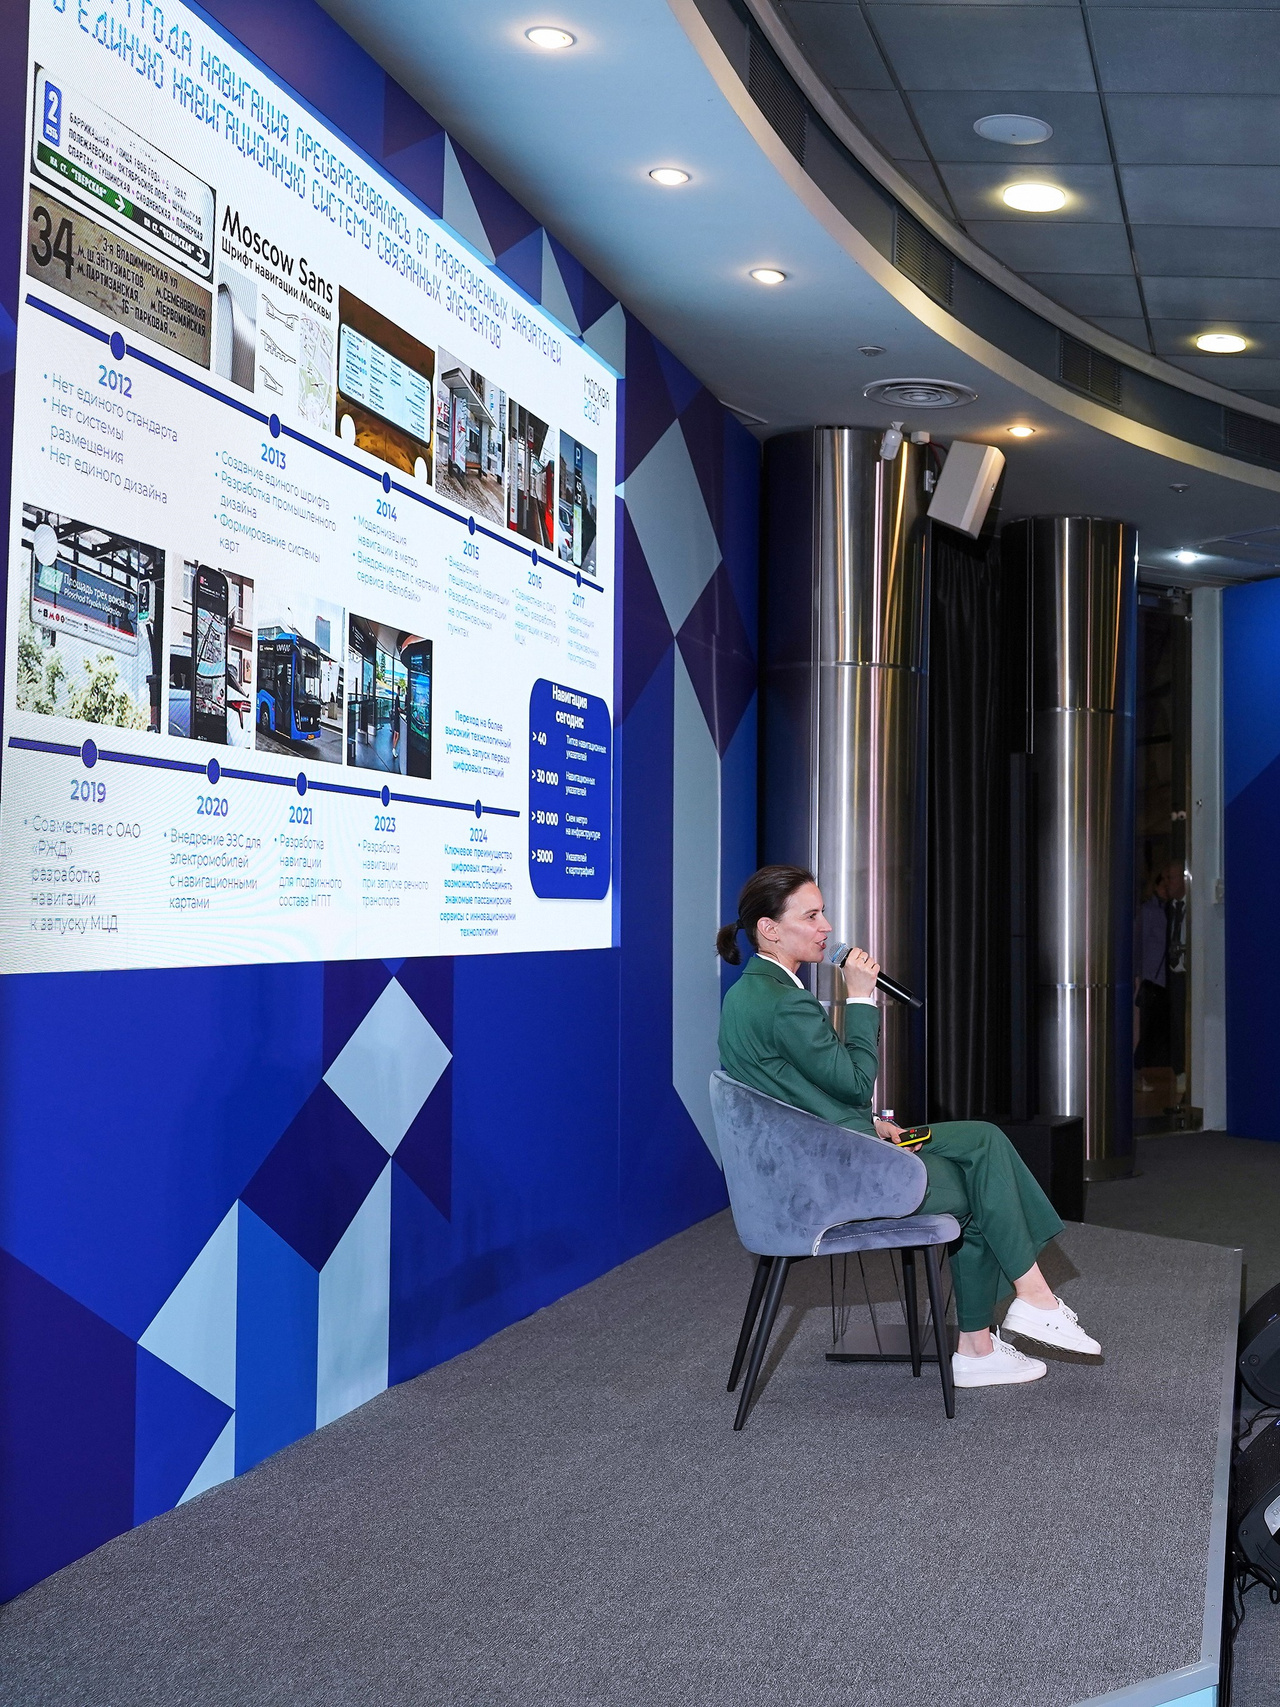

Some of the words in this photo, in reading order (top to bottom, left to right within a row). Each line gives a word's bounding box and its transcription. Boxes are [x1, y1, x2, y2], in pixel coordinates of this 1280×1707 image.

[48, 90, 59, 124] 2
[78, 0, 164, 89] ЕДИНУЮ
[173, 67, 306, 199] НАВИГАЦИОННУЮ
[312, 179, 371, 251] СИСТЕМУ
[378, 231, 442, 305] СВЯЗАННЫХ
[446, 285, 501, 349] ЭЛЕМЕНТОВ
[200, 45, 290, 146] НАВИГАЦИЯ
[296, 127, 411, 245] ПРЕОБРАЗОВАЛАСЬ
[417, 228, 430, 259] ОТ
[436, 243, 508, 324] РАЗРОЗНЕННЫХ
[511, 306, 562, 366] УКАЗАТЕЛЕЙ
[31, 205, 75, 281] 34
[222, 204, 295, 277] Moscow
[298, 257, 334, 304] Sans
[221, 235, 254, 269] Шрифт
[254, 262, 299, 299] навигации
[299, 289, 332, 321] Москвы
[98, 364, 132, 398] 2012
[583, 374, 610, 411] МОСКВА
[51, 396, 74, 418] Нет
[76, 411, 124, 441] системы
[53, 373, 74, 395] Нет
[77, 387, 124, 418] единого
[126, 410, 178, 442] стандарта
[583, 397, 601, 427] 2030
[50, 425, 124, 465] размещения
[260, 443, 287, 470] 2013
[49, 445, 72, 467] Нет
[74, 458, 121, 487] единого
[123, 477, 168, 504] дизайна
[221, 450, 264, 481] Создание
[265, 473, 299, 497] единого
[300, 488, 330, 511] шрифта
[220, 495, 257, 519] дизайна
[221, 470, 271, 504] Разработка
[272, 495, 337, 532] промышленного
[376, 498, 397, 522] 2014
[219, 513, 286, 551] Формирование
[287, 542, 321, 563] системы
[219, 537, 240, 554] карт
[463, 540, 480, 560] 2015
[528, 571, 543, 590] 2016
[572, 592, 586, 609] 2017
[552, 684, 588, 710] Навигация
[70, 779, 107, 803] 2019
[196, 795, 229, 817] 2020
[289, 805, 313, 825] 2021
[33, 815, 104, 836] Совместная
[116, 822, 141, 839] ОАО
[374, 815, 397, 833] 2023
[469, 827, 488, 843] 2024
[170, 828, 225, 848] Внедрение
[245, 837, 261, 850] для
[279, 834, 325, 850] Разработка
[362, 839, 401, 855] Разработка
[169, 852, 249, 869] электромобилей
[279, 856, 322, 869] навигации
[362, 860, 399, 872] навигации
[31, 865, 101, 886] разработка
[177, 876, 258, 890] навигационными
[279, 876, 294, 888] для
[295, 877, 343, 890] подвижного
[31, 892, 96, 908] навигации
[169, 897, 210, 912] картами
[279, 895, 309, 907] состава
[362, 896, 401, 909] транспорта
[31, 917, 38, 931] к
[40, 917, 89, 935] запуску
[91, 915, 119, 933] МЦД
